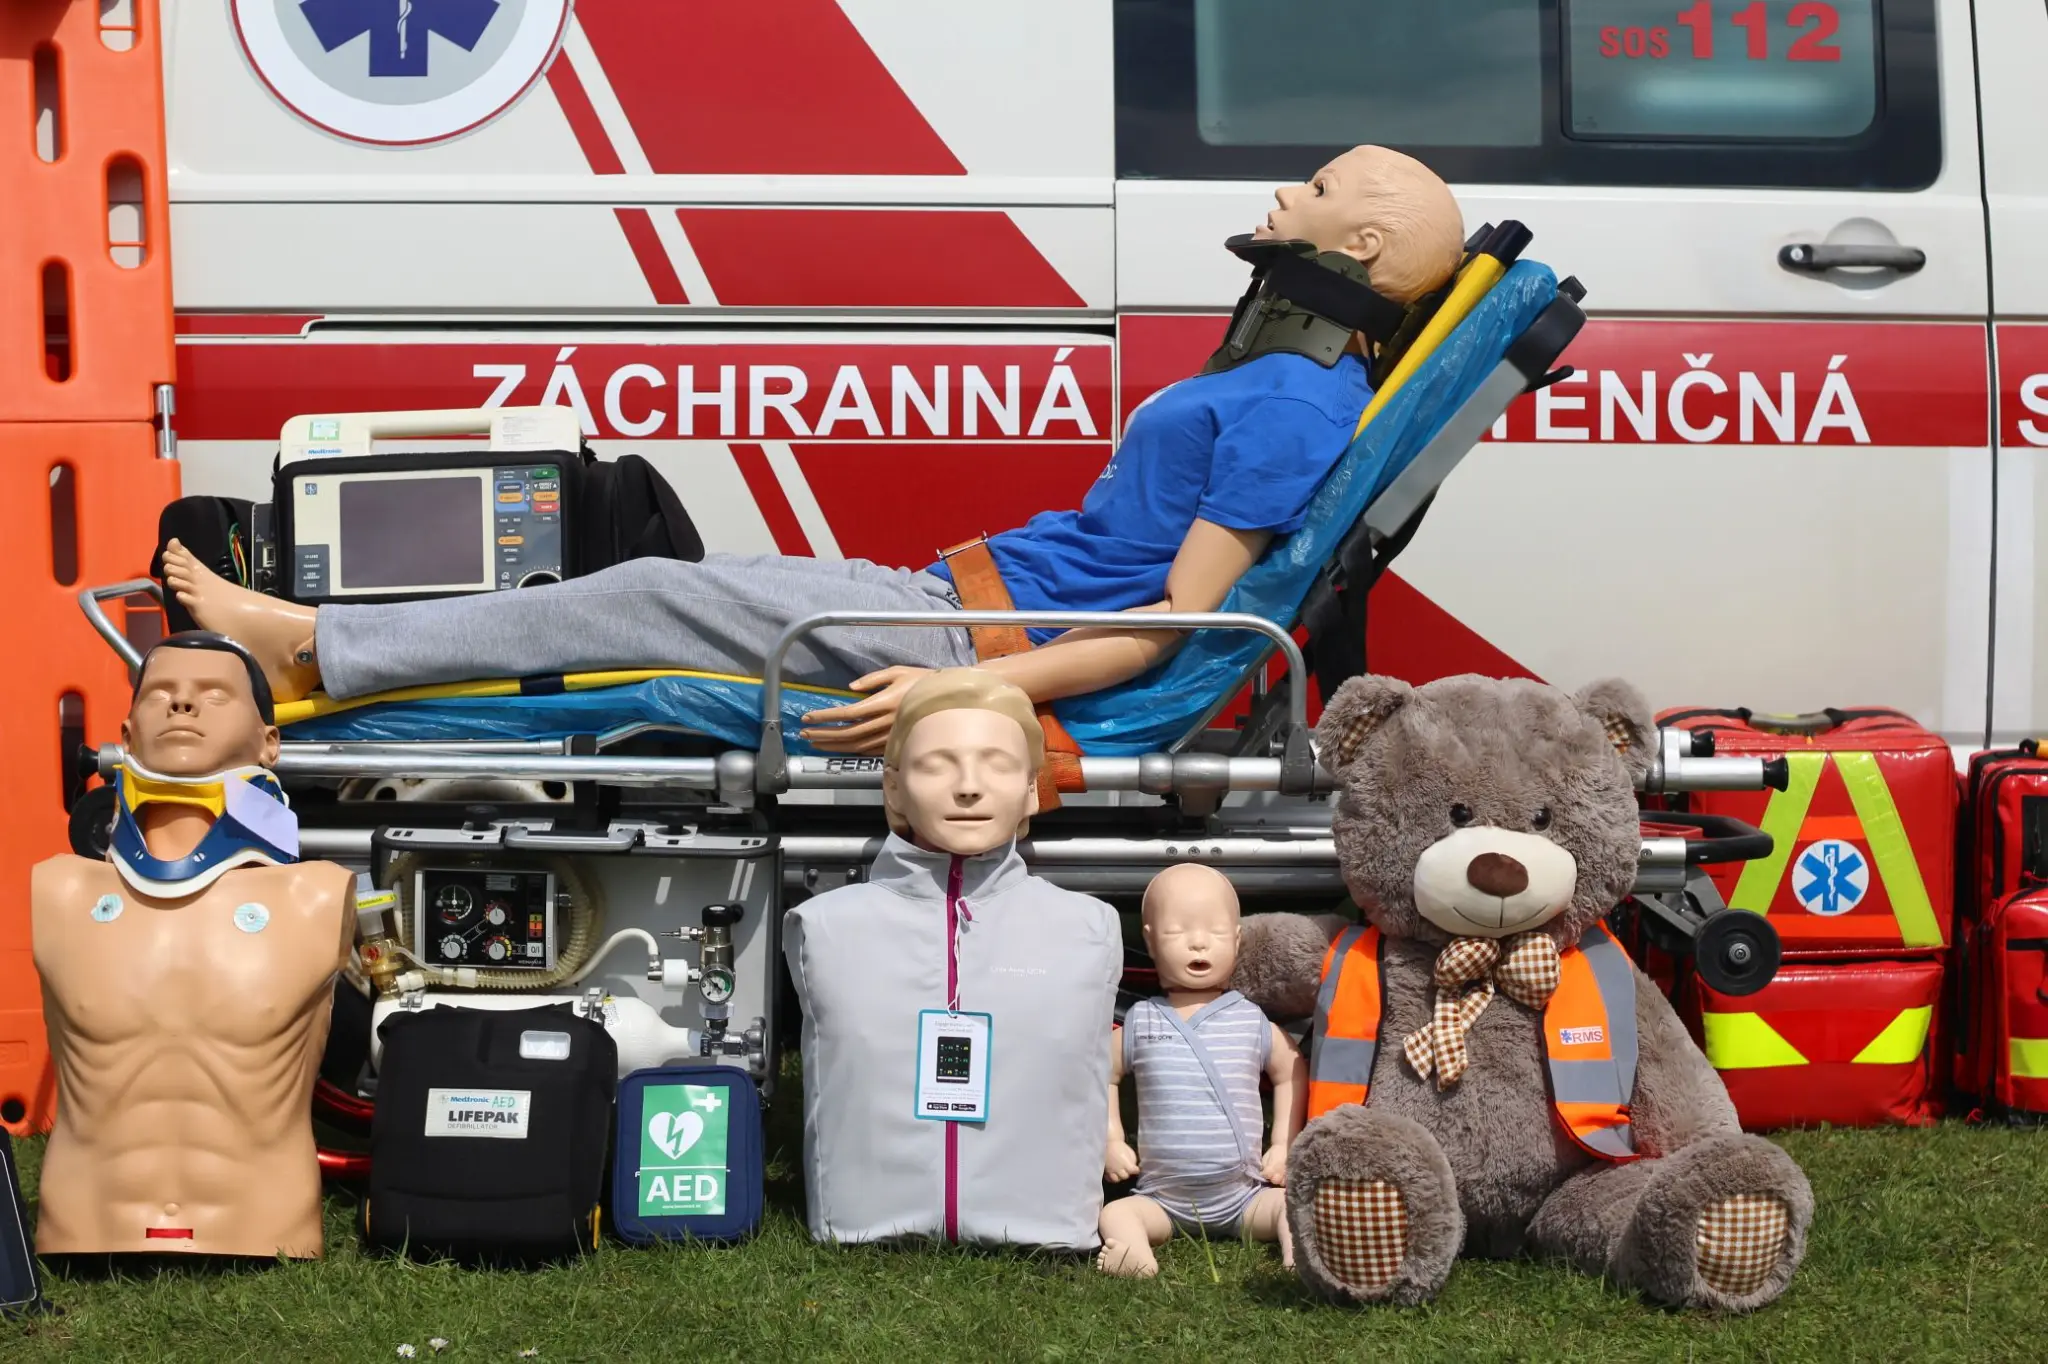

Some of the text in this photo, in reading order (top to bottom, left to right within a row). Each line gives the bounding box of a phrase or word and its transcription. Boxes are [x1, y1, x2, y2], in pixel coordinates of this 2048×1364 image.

[1599, 1, 1842, 62] SOS 112
[472, 346, 1099, 437] ZÁCHRANNÁ
[1572, 1030, 1603, 1043] RMS
[492, 1096, 515, 1108] AED
[448, 1110, 519, 1124] LIFEPAK
[645, 1174, 719, 1202] AED
